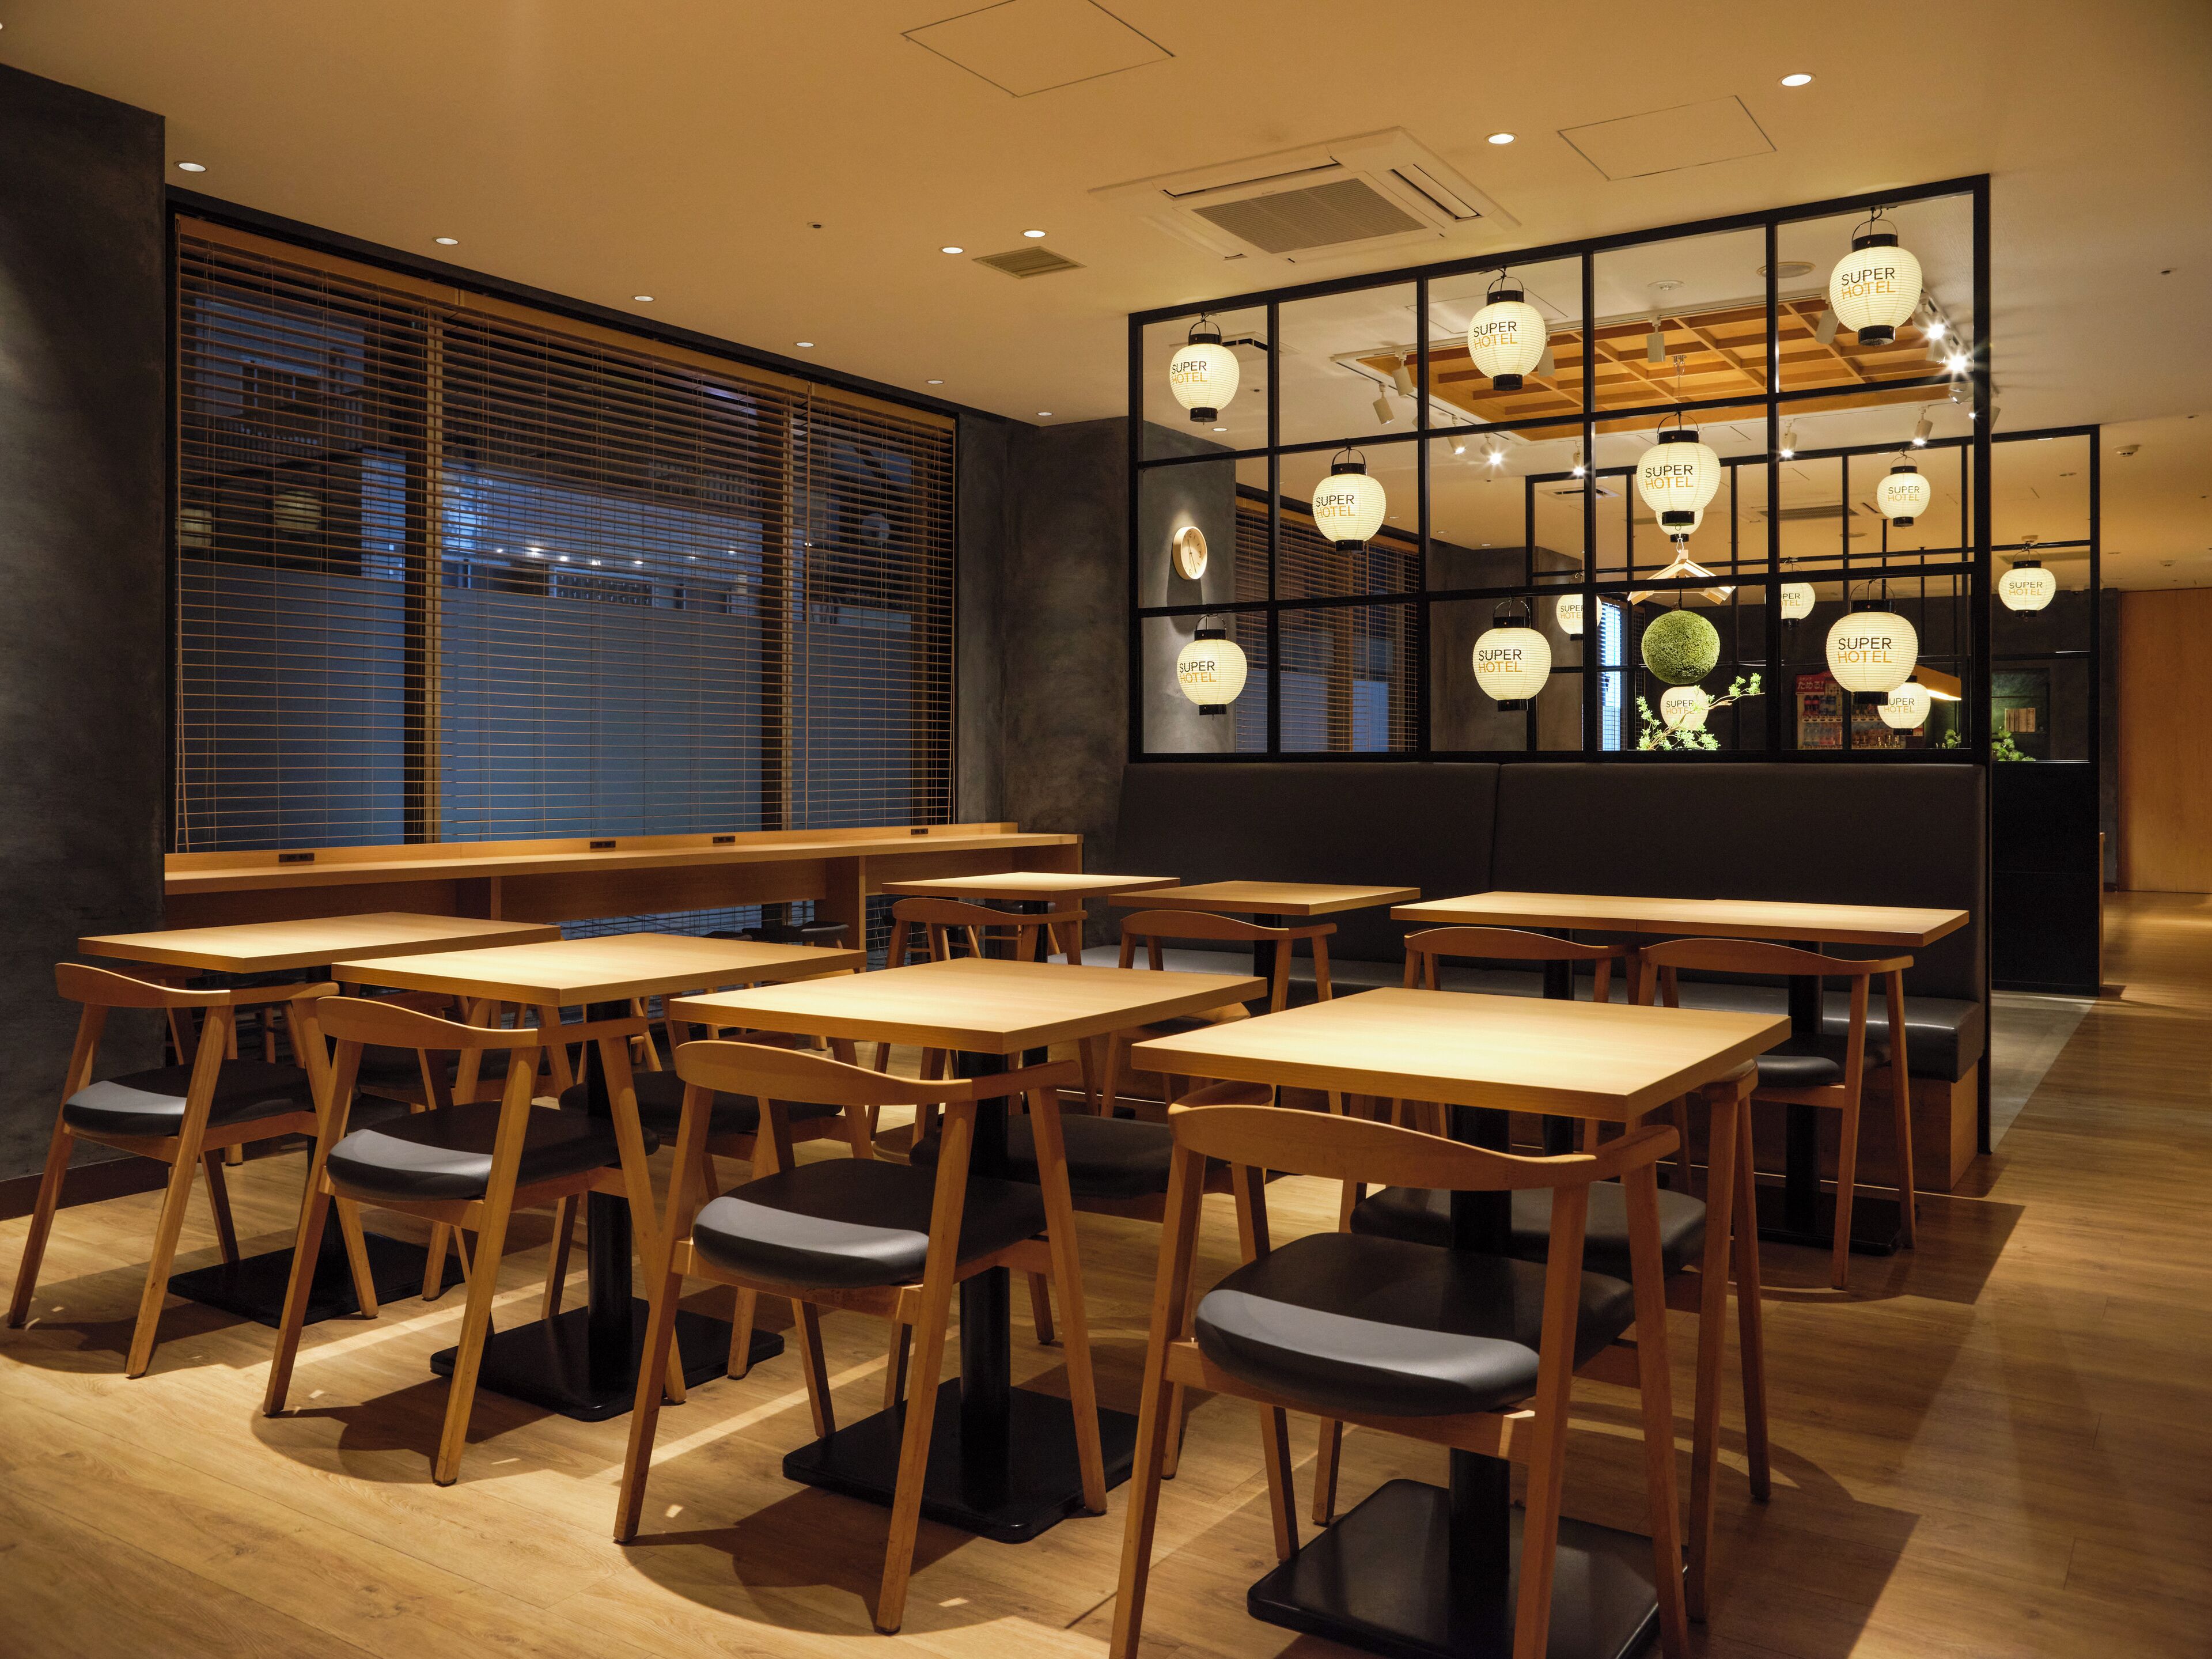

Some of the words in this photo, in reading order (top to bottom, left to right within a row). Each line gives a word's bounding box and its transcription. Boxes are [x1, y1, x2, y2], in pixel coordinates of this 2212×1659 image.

[1841, 267, 1895, 286] SUPER
[1842, 281, 1896, 300] HOTEL
[1474, 321, 1517, 338] SUPER
[1474, 332, 1518, 350] HOTEL
[1171, 361, 1207, 374] SUPER
[1172, 372, 1208, 385] HOTEL
[1645, 464, 1693, 478] SUPER
[1645, 476, 1694, 490] HOTEL
[1888, 486, 1920, 494] SUPER
[1316, 494, 1355, 507] SUPER
[1888, 494, 1919, 502] HOTEL
[1316, 505, 1355, 518] HOTEL
[1838, 637, 1892, 650] SUPER
[1478, 649, 1522, 661] SUPER
[1838, 650, 1892, 664] HOTEL
[1179, 661, 1215, 673] SUPER
[1478, 661, 1522, 673] HOTEL
[1180, 672, 1217, 684] HOTEL
[1889, 698, 1915, 706] UPER
[1884, 705, 1915, 713] HOTEL
